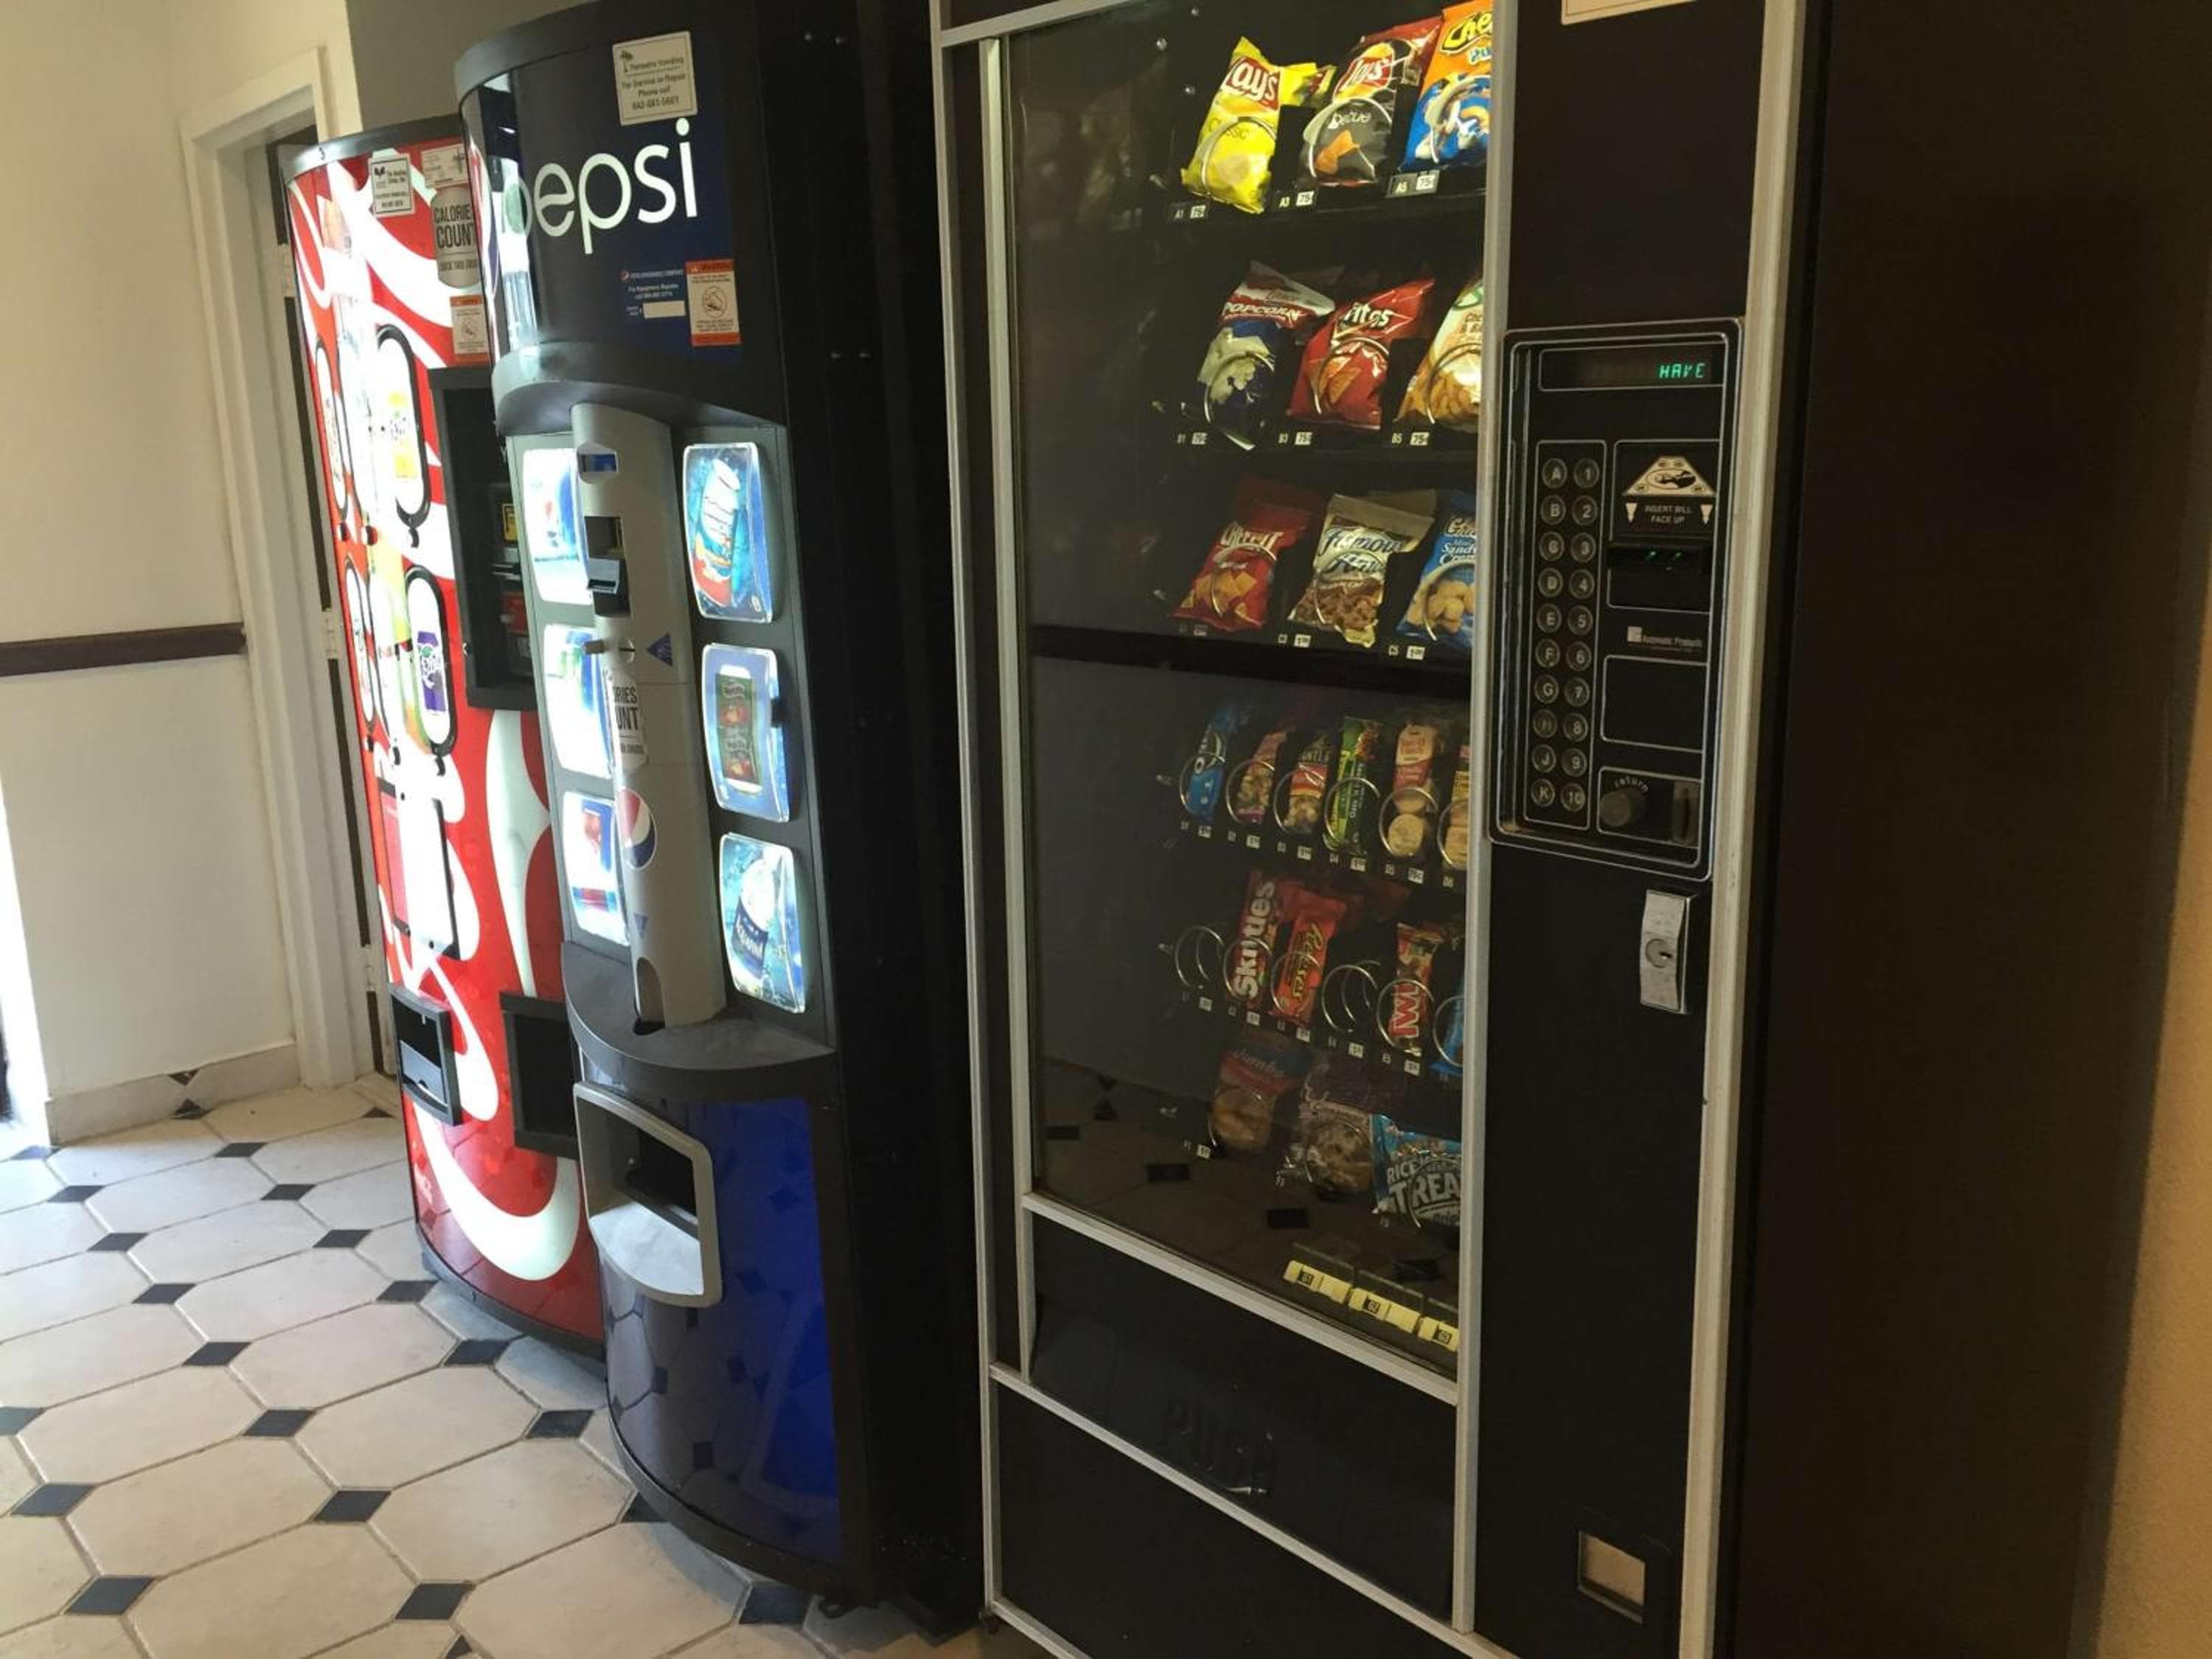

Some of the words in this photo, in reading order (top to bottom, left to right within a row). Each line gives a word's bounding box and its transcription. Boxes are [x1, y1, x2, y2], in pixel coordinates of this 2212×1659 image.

[434, 204, 470, 223] CALORIE
[1659, 363, 1706, 379] HAVE
[1391, 1172, 1461, 1215] TREA
